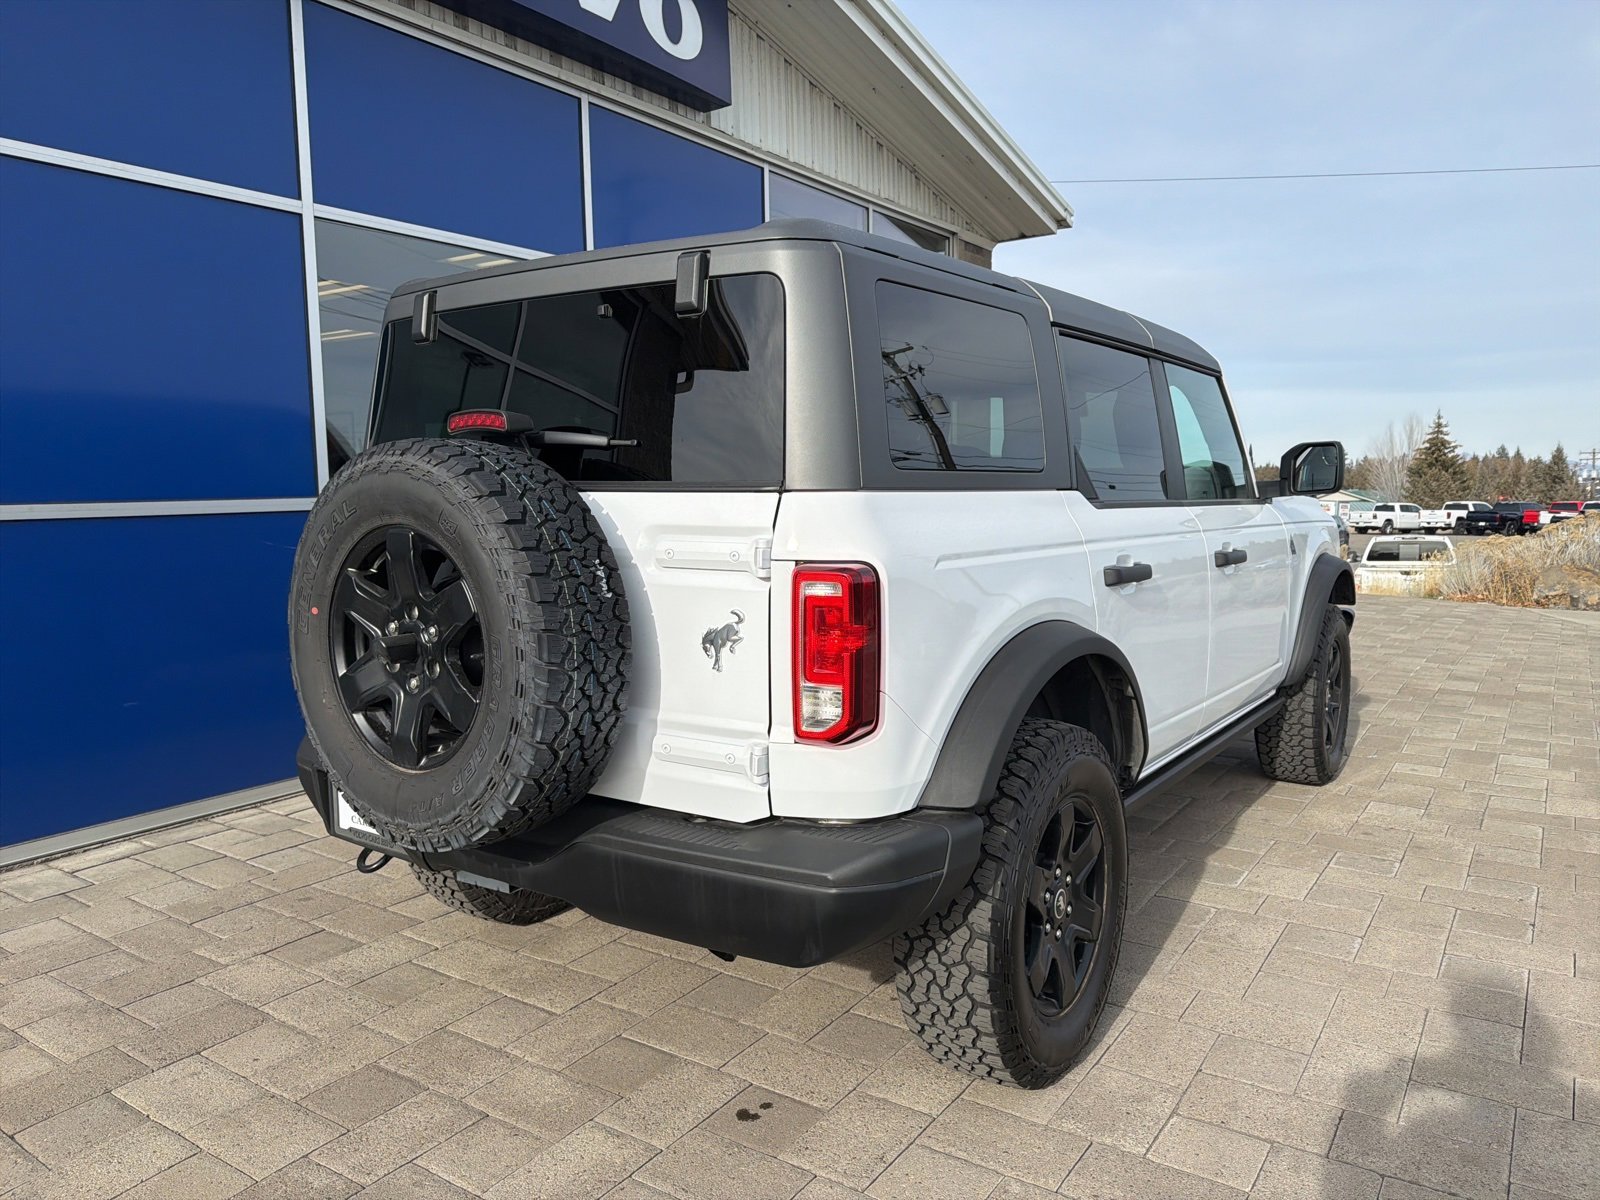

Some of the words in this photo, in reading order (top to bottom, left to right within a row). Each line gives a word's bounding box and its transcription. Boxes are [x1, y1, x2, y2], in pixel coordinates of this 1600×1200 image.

[579, 0, 703, 60] O
[297, 500, 357, 635] GENERAL
[451, 633, 504, 796] GRABBER
